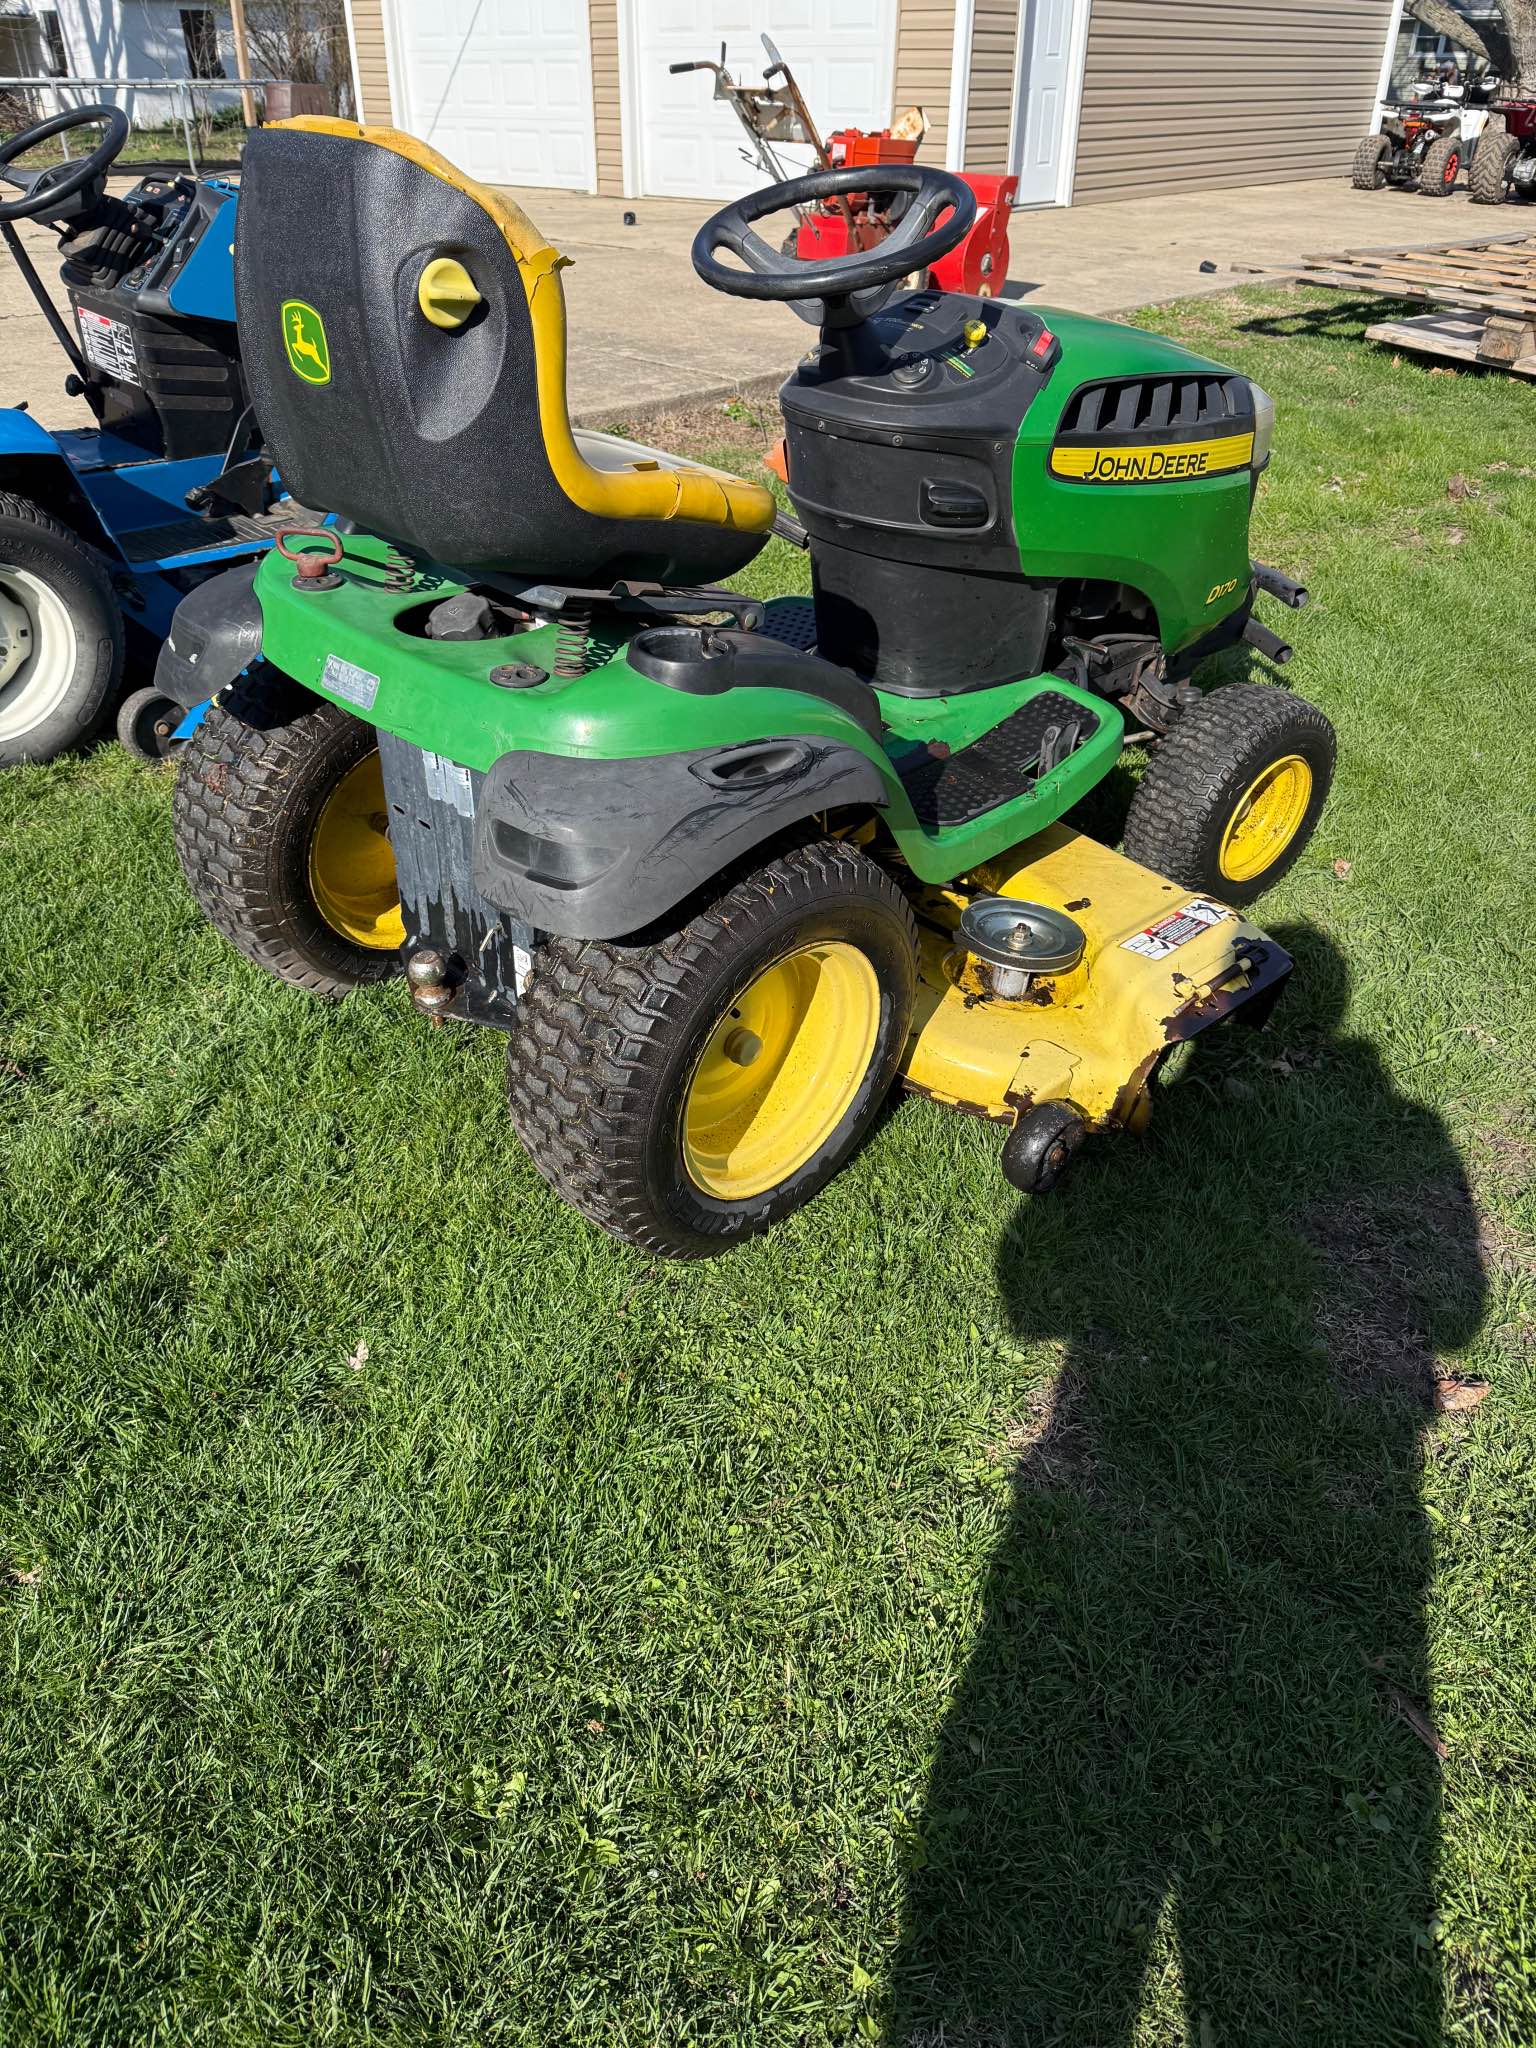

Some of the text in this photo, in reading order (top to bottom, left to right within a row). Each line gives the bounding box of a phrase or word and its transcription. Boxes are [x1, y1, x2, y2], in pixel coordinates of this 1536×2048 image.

[1083, 451, 1209, 479] JOHN DEERE
[1205, 578, 1238, 605] D170
